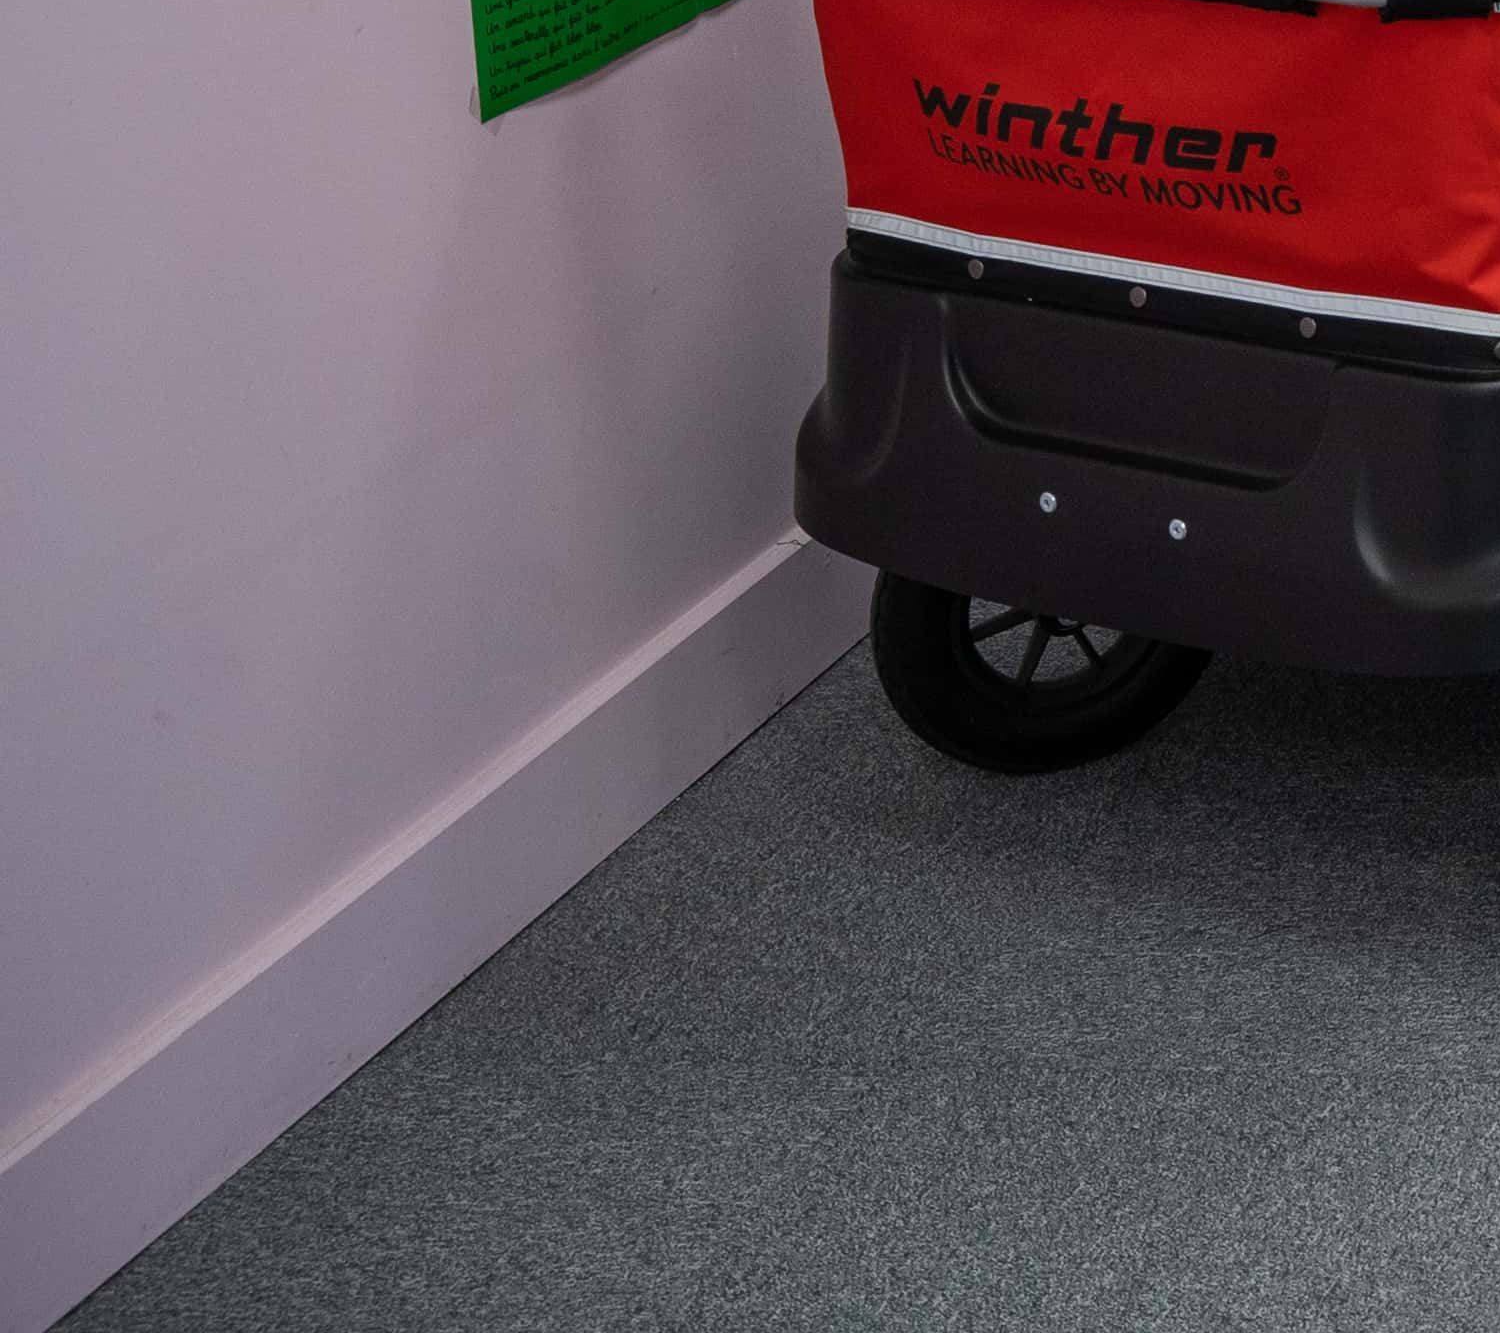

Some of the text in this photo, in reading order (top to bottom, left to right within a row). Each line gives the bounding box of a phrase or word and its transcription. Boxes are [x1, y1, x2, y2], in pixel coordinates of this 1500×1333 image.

[913, 78, 1277, 173] winther
[927, 127, 1302, 216] LEARNING BY MOVING
